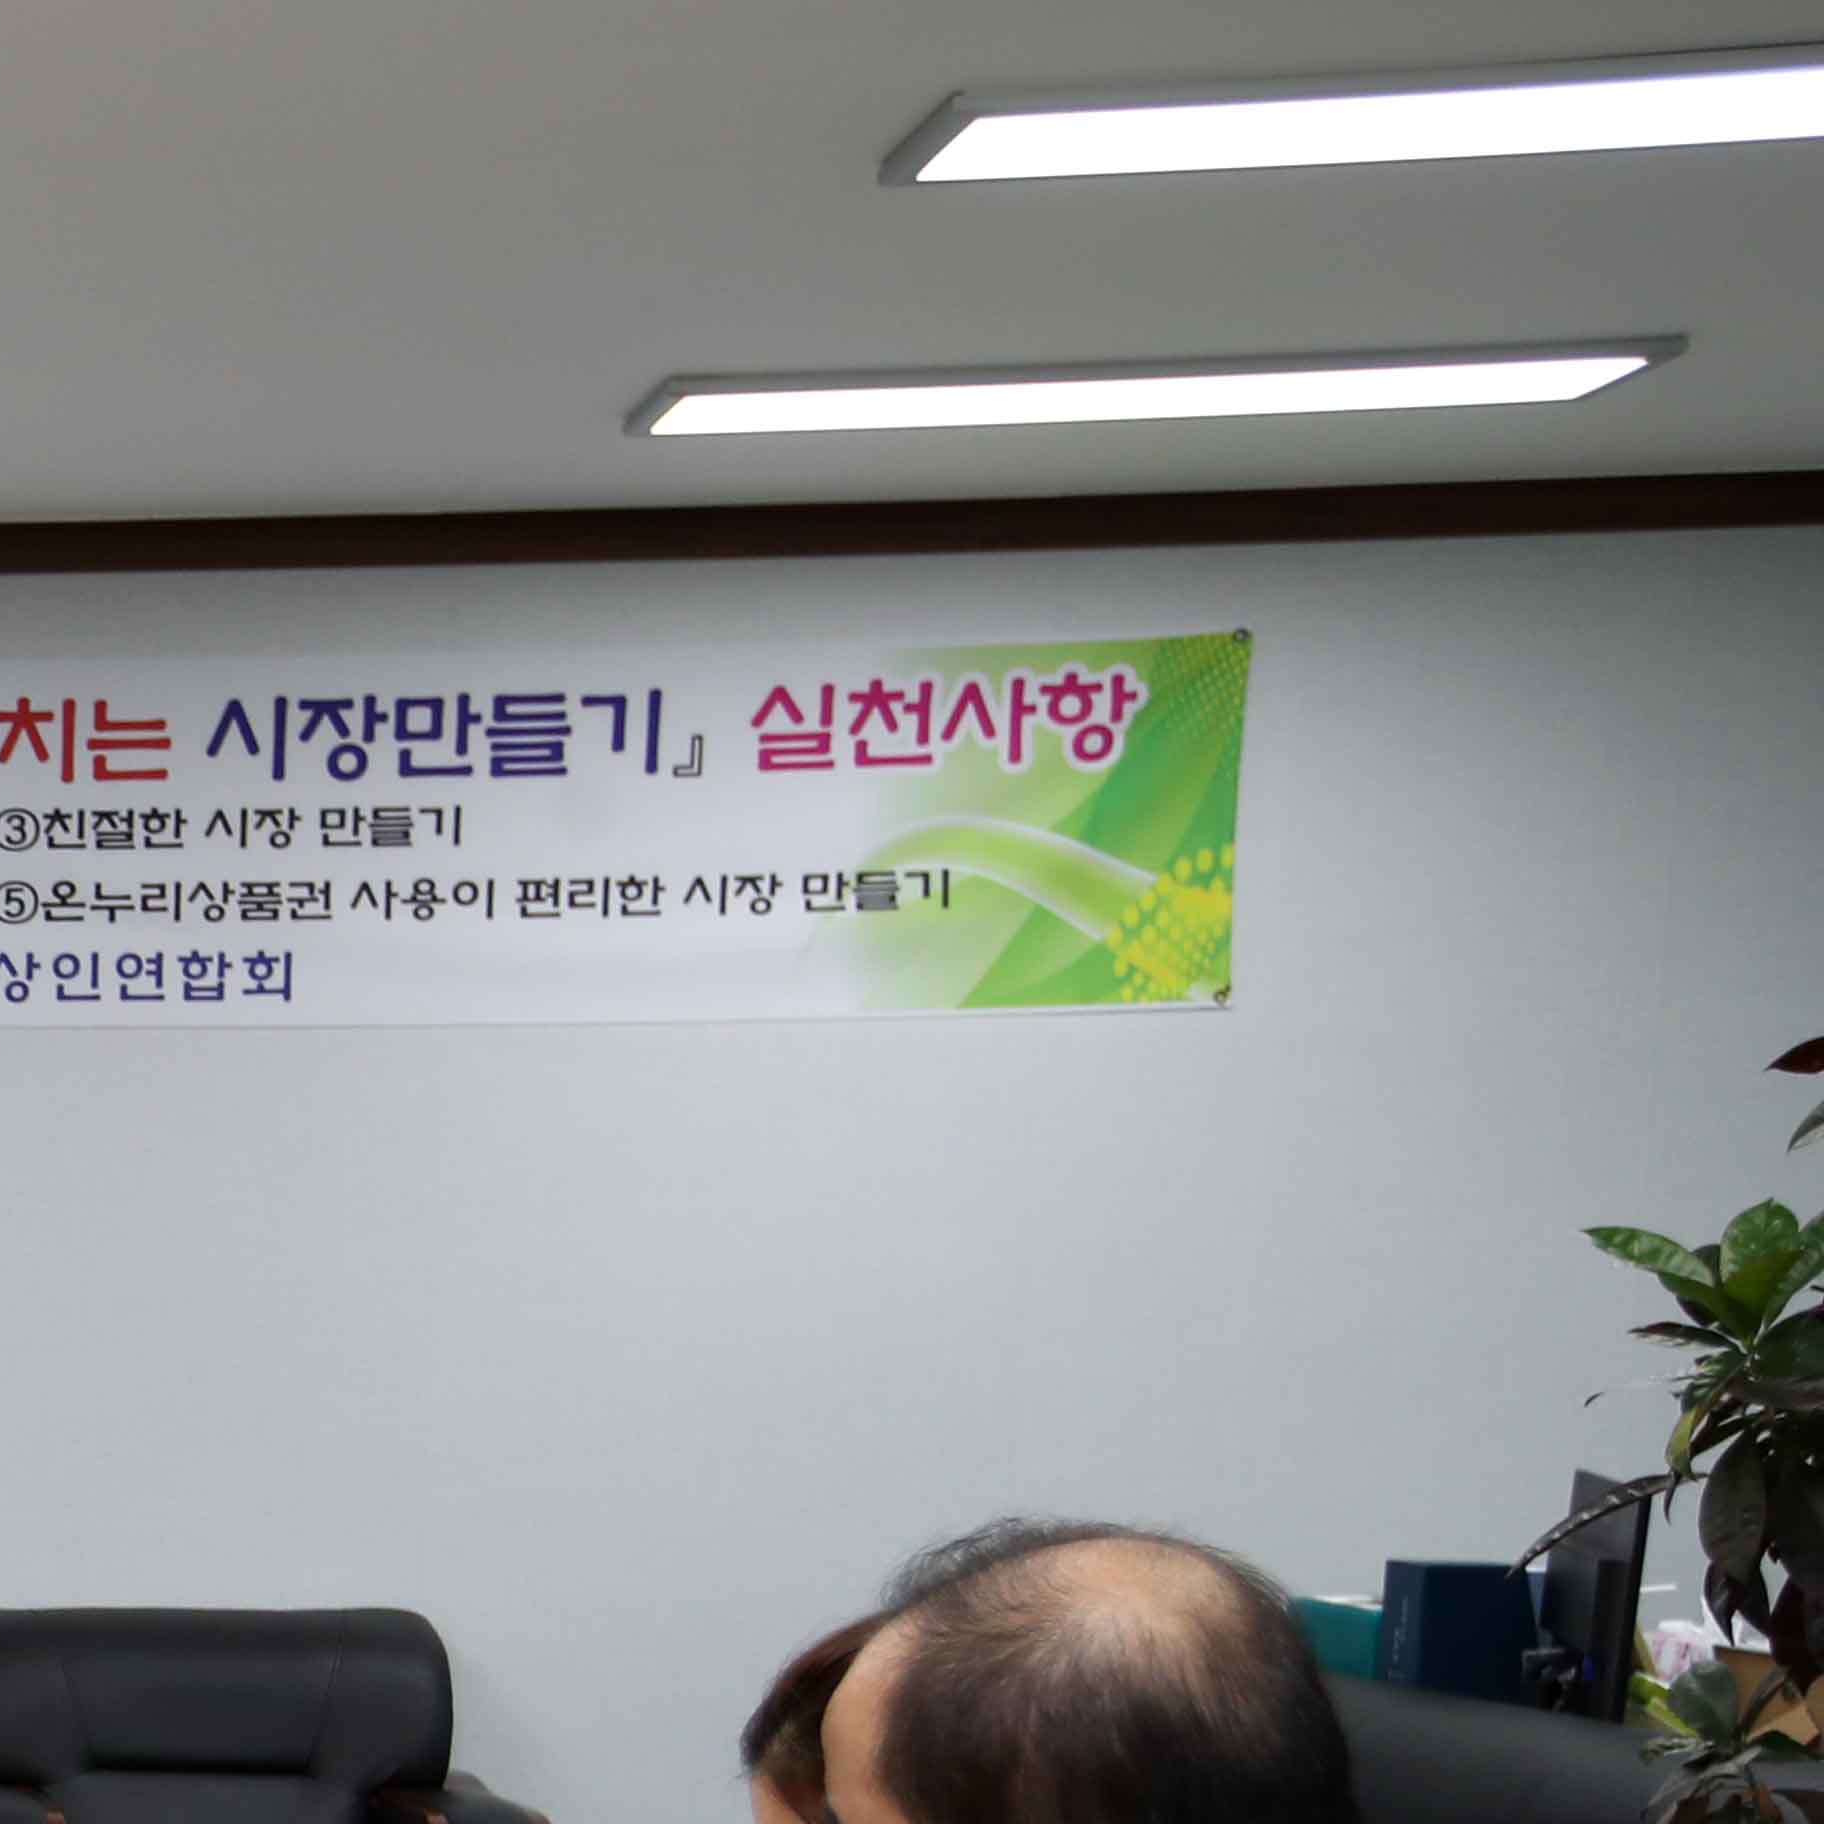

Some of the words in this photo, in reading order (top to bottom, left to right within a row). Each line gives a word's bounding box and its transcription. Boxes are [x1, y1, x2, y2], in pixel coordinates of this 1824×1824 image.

[751, 673, 1137, 771] 실천사항
[204, 807, 302, 849] 시장
[319, 804, 462, 848] 만들기
[350, 877, 495, 921] 사용이
[516, 875, 665, 918] 편리한
[684, 873, 782, 915] 시장
[802, 868, 950, 911] 만들기
